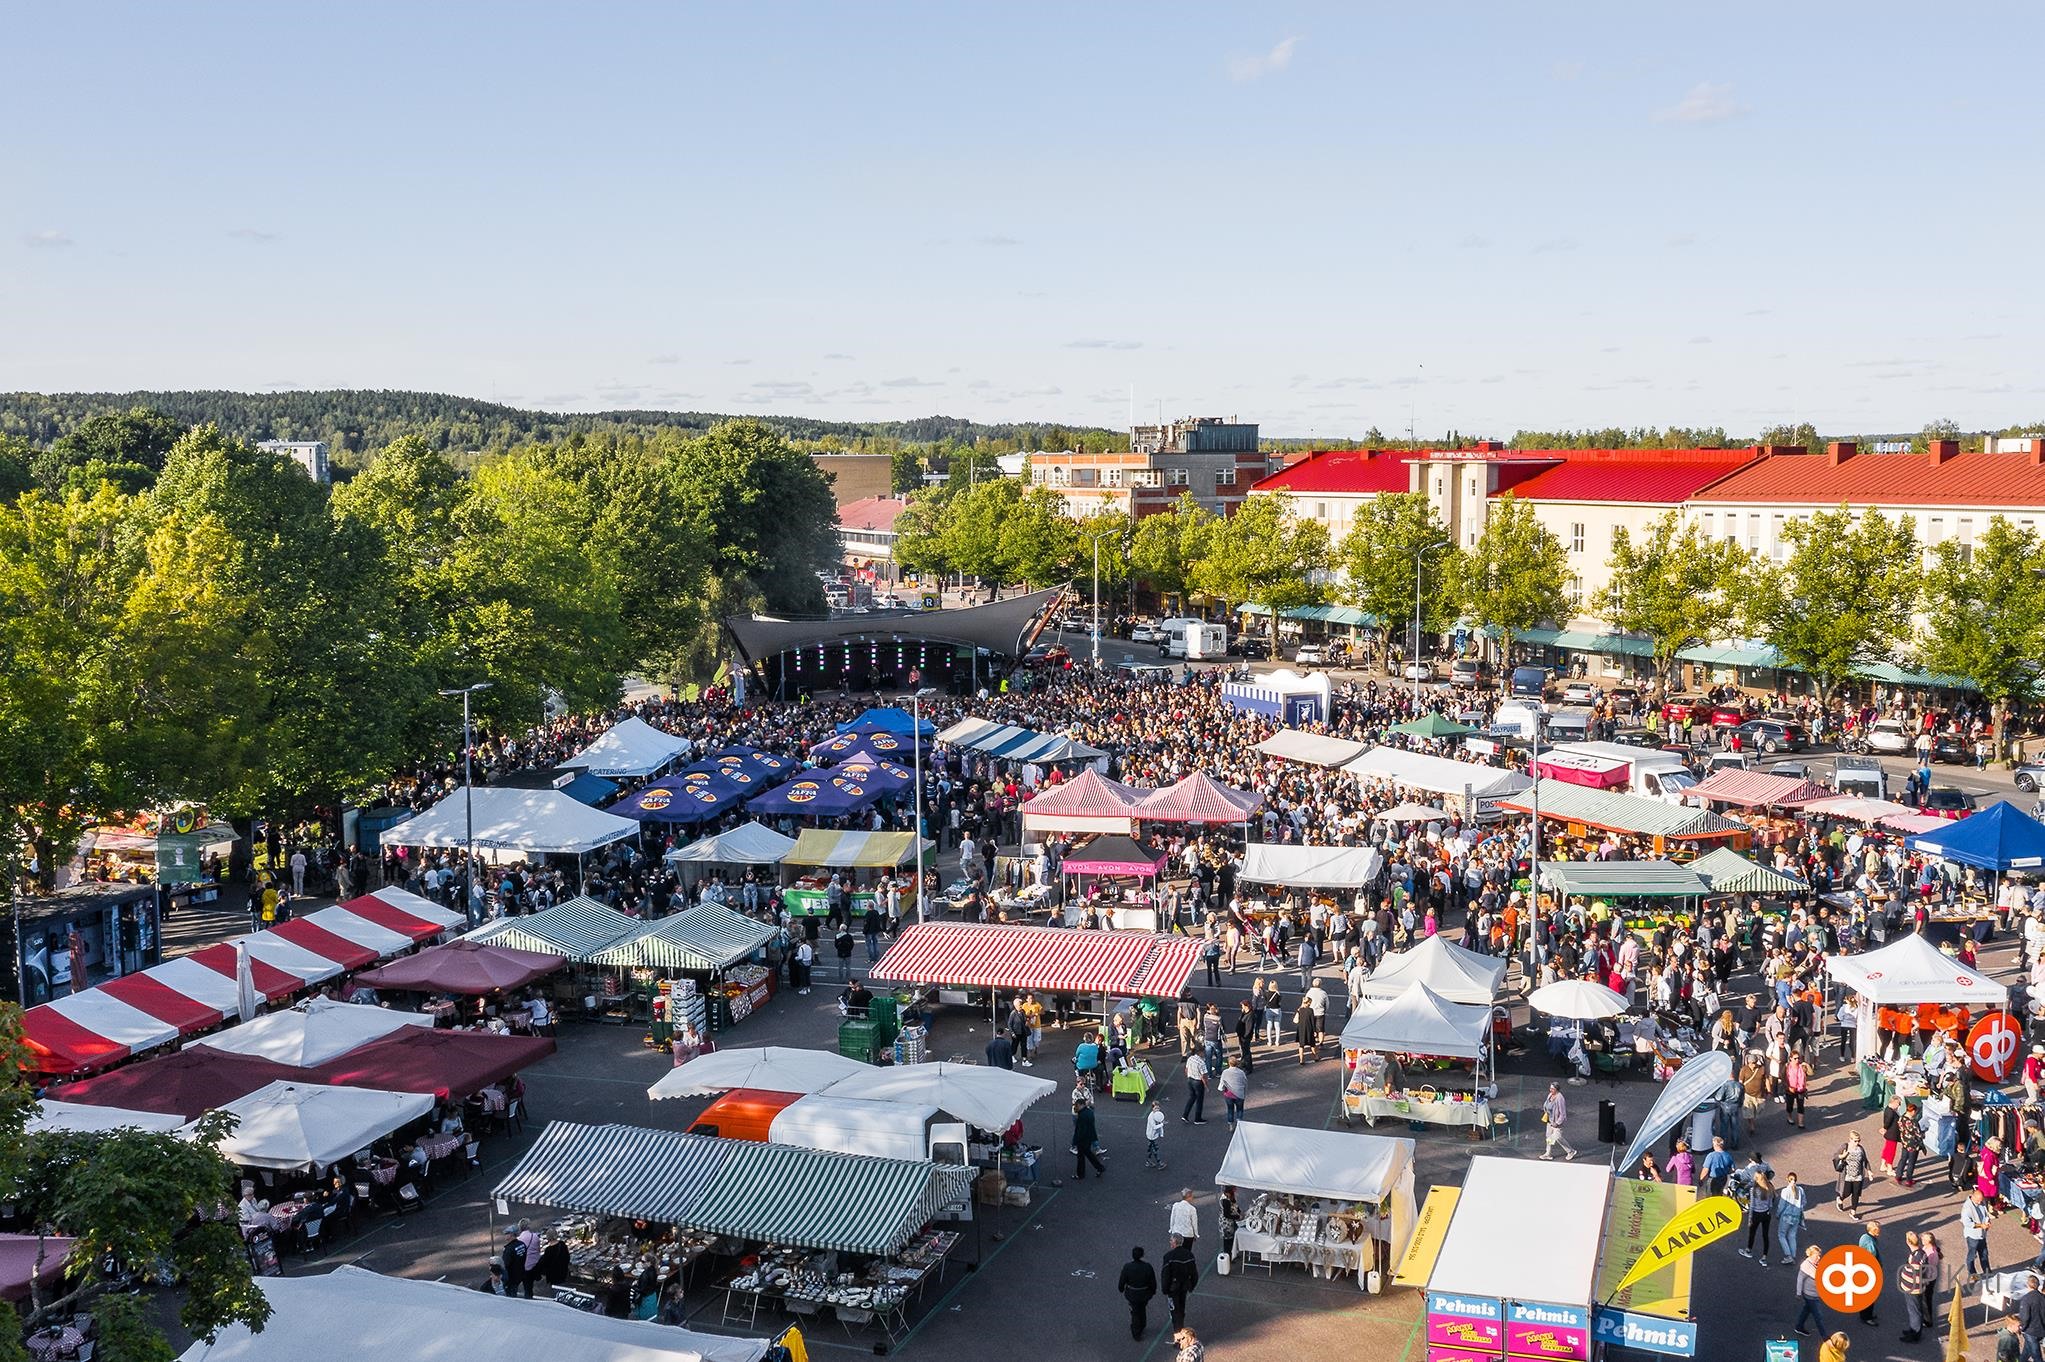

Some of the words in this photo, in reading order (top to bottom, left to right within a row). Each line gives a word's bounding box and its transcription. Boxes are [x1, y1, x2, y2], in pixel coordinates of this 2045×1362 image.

[1650, 1211, 1732, 1260] LAKUA
[1434, 1297, 1496, 1317] Pehmis
[1514, 1307, 1578, 1325] Pehmis
[1597, 1317, 1689, 1348] Pehmis
